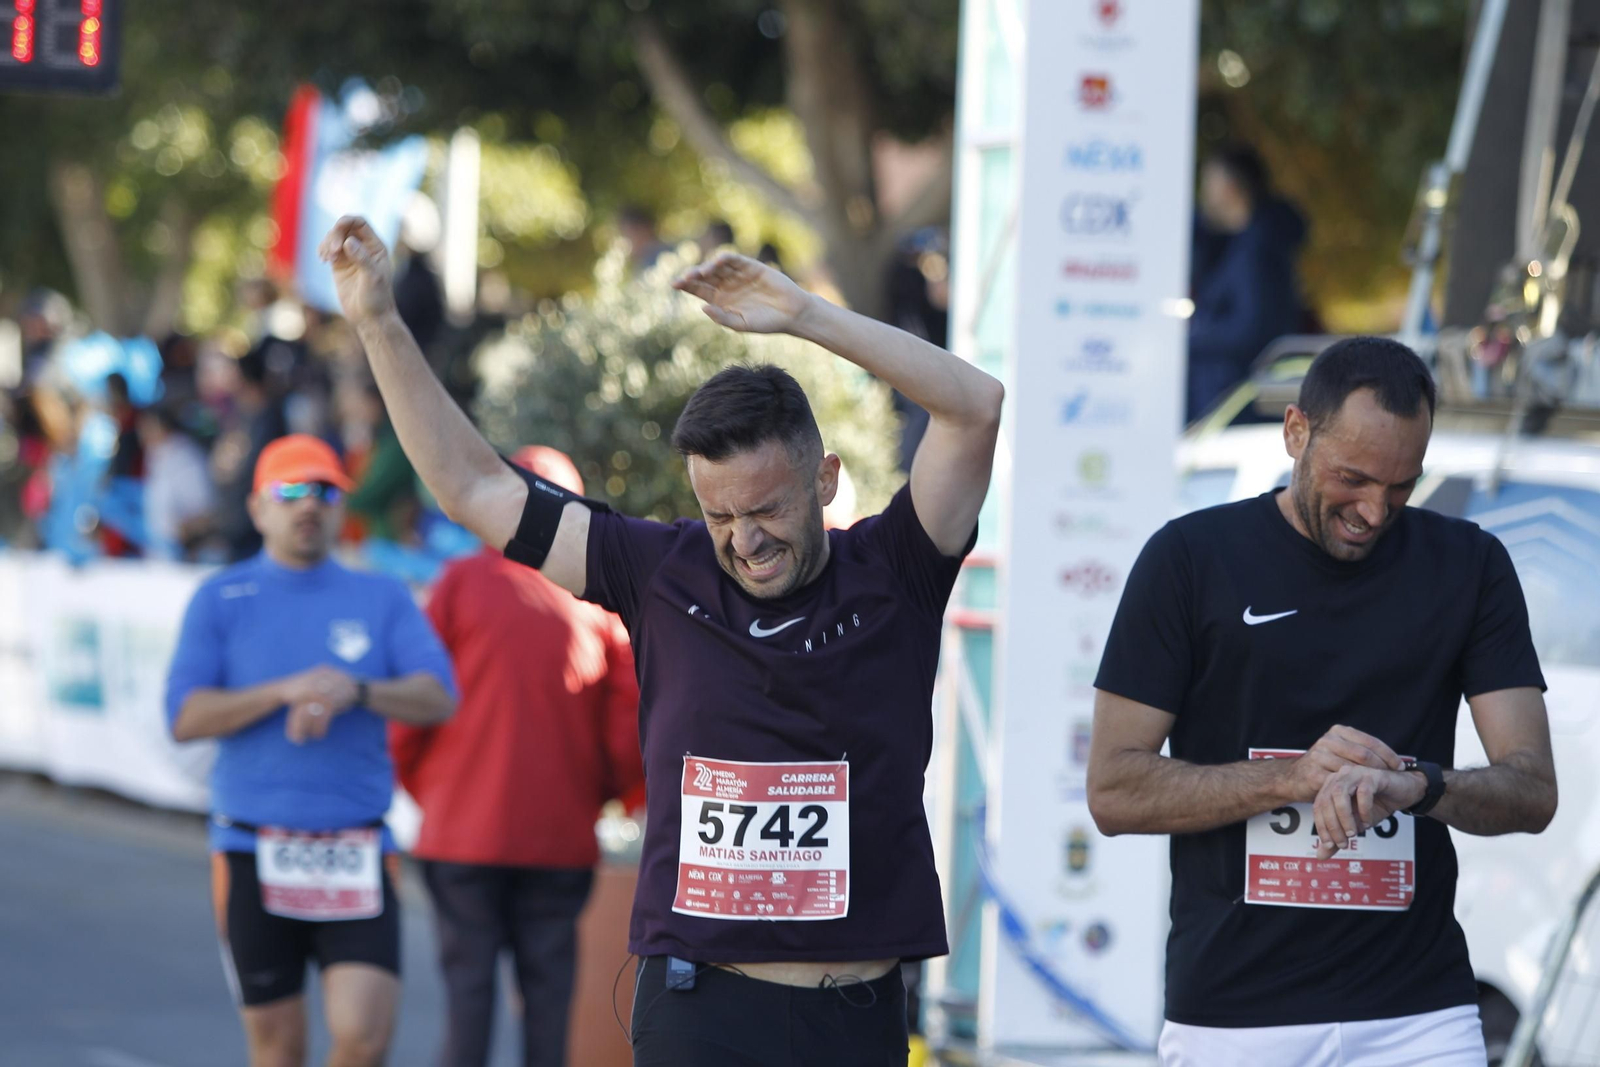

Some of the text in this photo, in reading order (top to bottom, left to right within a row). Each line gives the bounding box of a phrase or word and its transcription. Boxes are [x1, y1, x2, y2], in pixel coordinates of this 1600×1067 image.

[781, 773, 836, 784] CARRERA
[767, 785, 836, 796] SALUDABLE
[697, 800, 829, 849] 5742
[699, 845, 822, 862] MATIAS SANTIAGO
